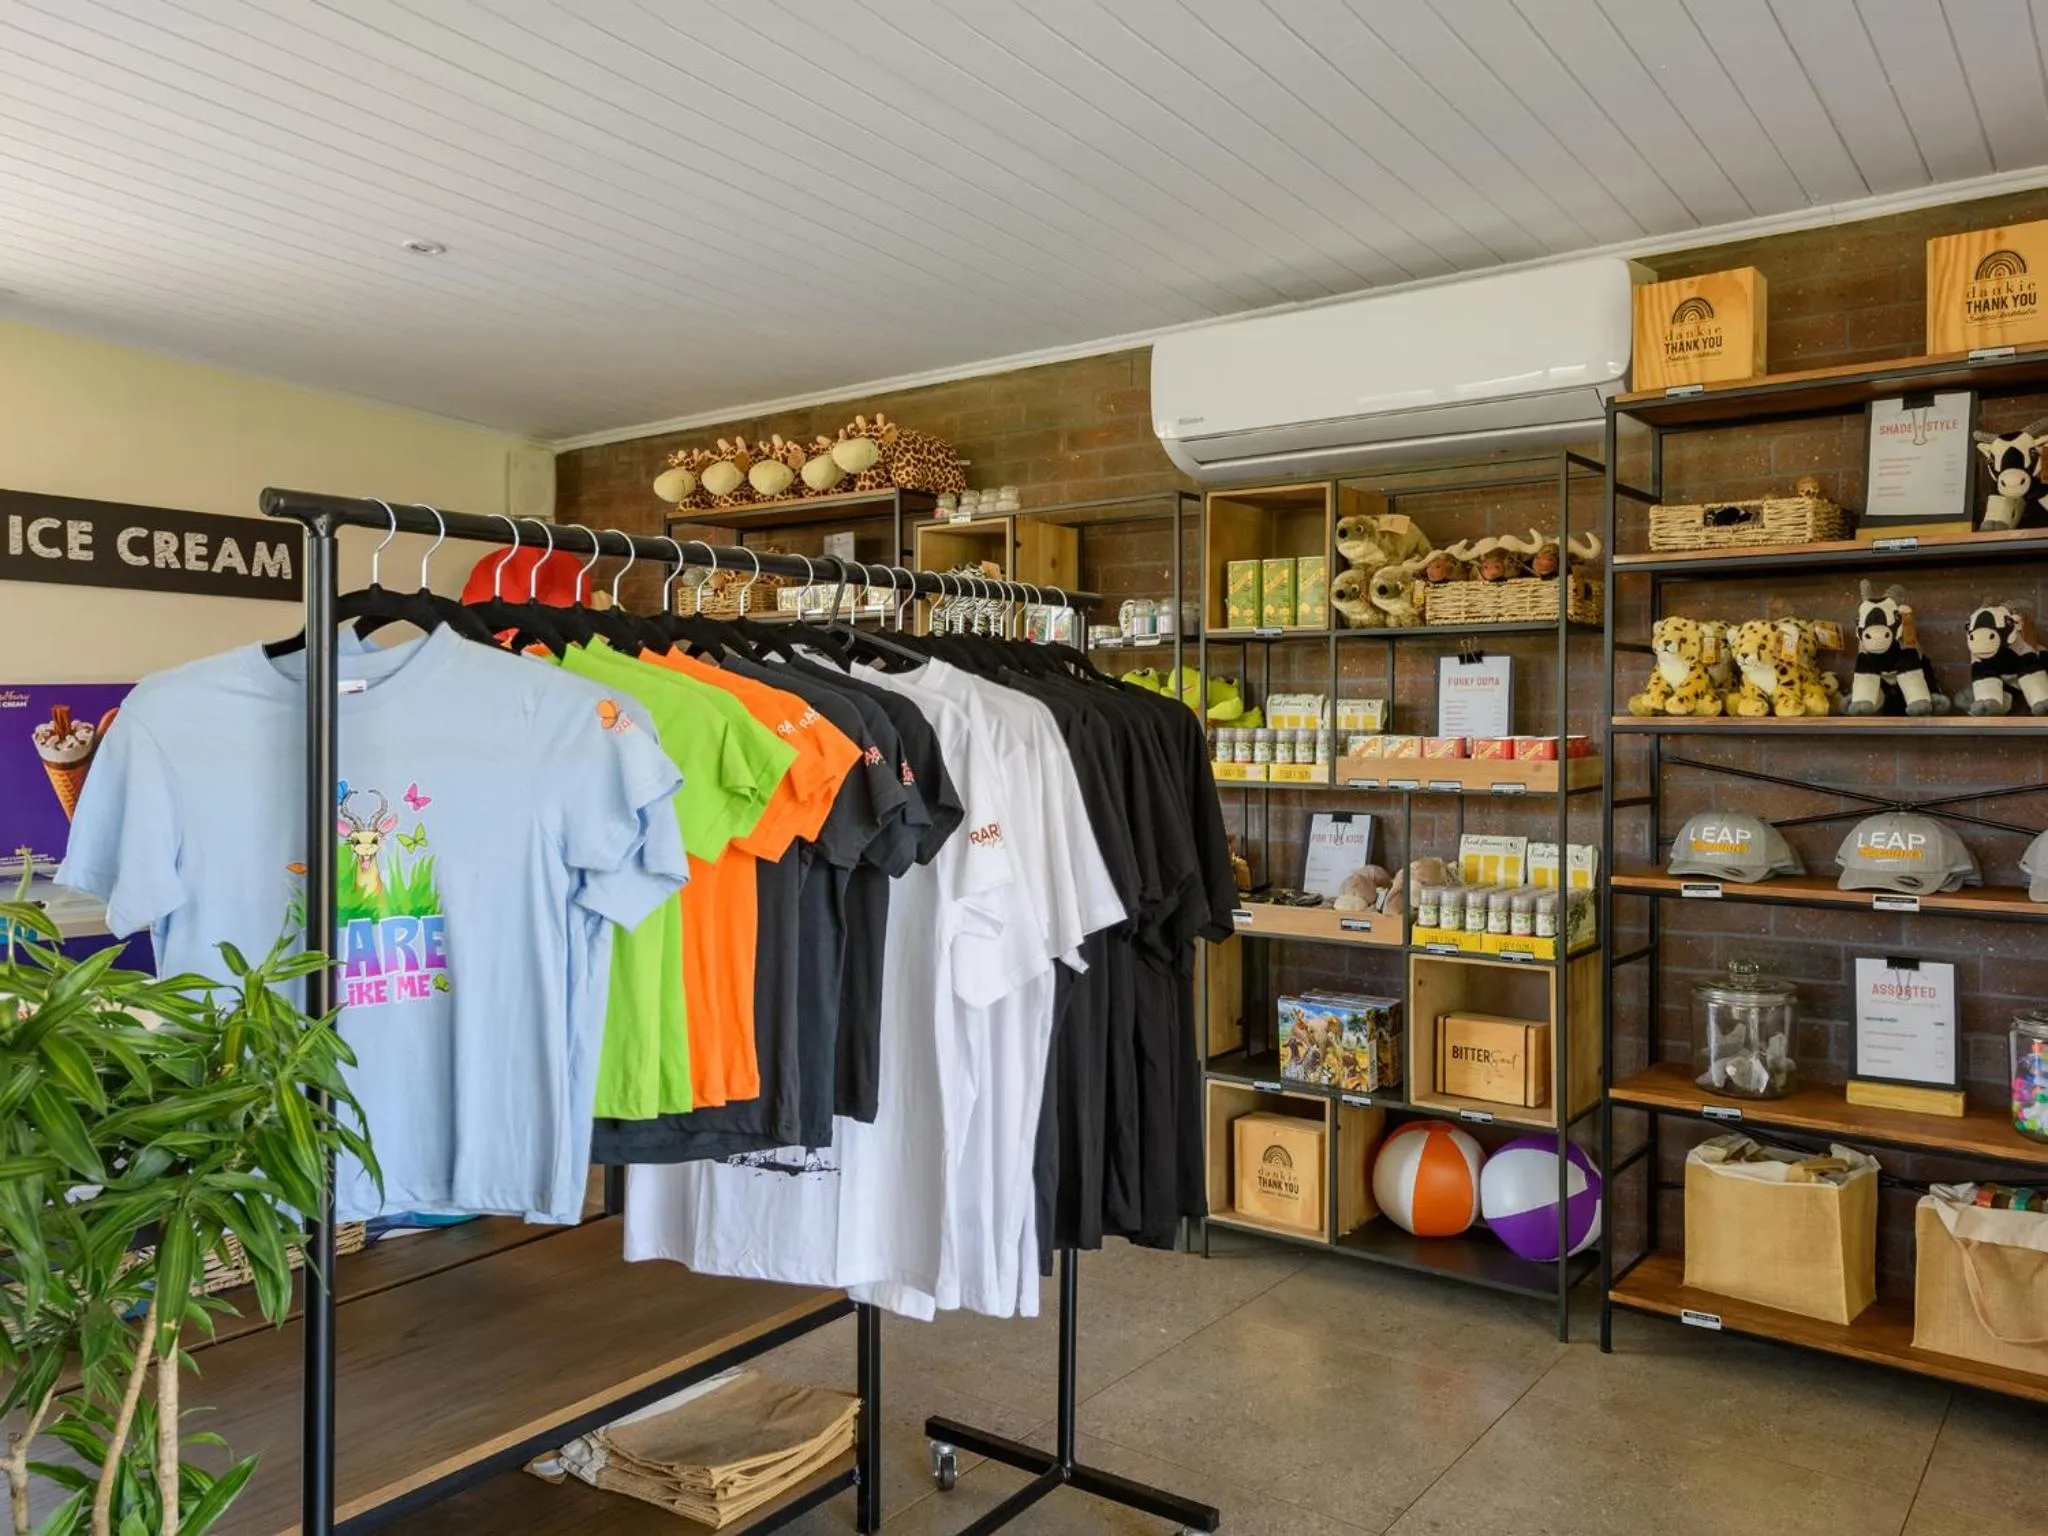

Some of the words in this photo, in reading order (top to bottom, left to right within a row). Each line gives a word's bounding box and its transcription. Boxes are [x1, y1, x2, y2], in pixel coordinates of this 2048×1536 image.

[1966, 296, 2009, 315] THANK
[2012, 292, 2037, 308] YOU
[1664, 338, 1700, 355] THANK
[1702, 335, 1723, 350] YOU
[1879, 424, 1912, 436] SHADE
[1926, 419, 1960, 432] STYLE
[8, 515, 95, 562] ICE
[116, 527, 293, 580] CREAM
[1690, 825, 1752, 845] LEAP
[1857, 831, 1927, 851] LEAP
[345, 915, 449, 979] ARE
[347, 979, 388, 1007] iKE
[397, 973, 431, 1001] ME
[1871, 983, 1937, 999] ASSORTED
[1452, 1045, 1491, 1063] BITTER
[1258, 1176, 1283, 1191] THANK
[1285, 1182, 1300, 1195] YOU
